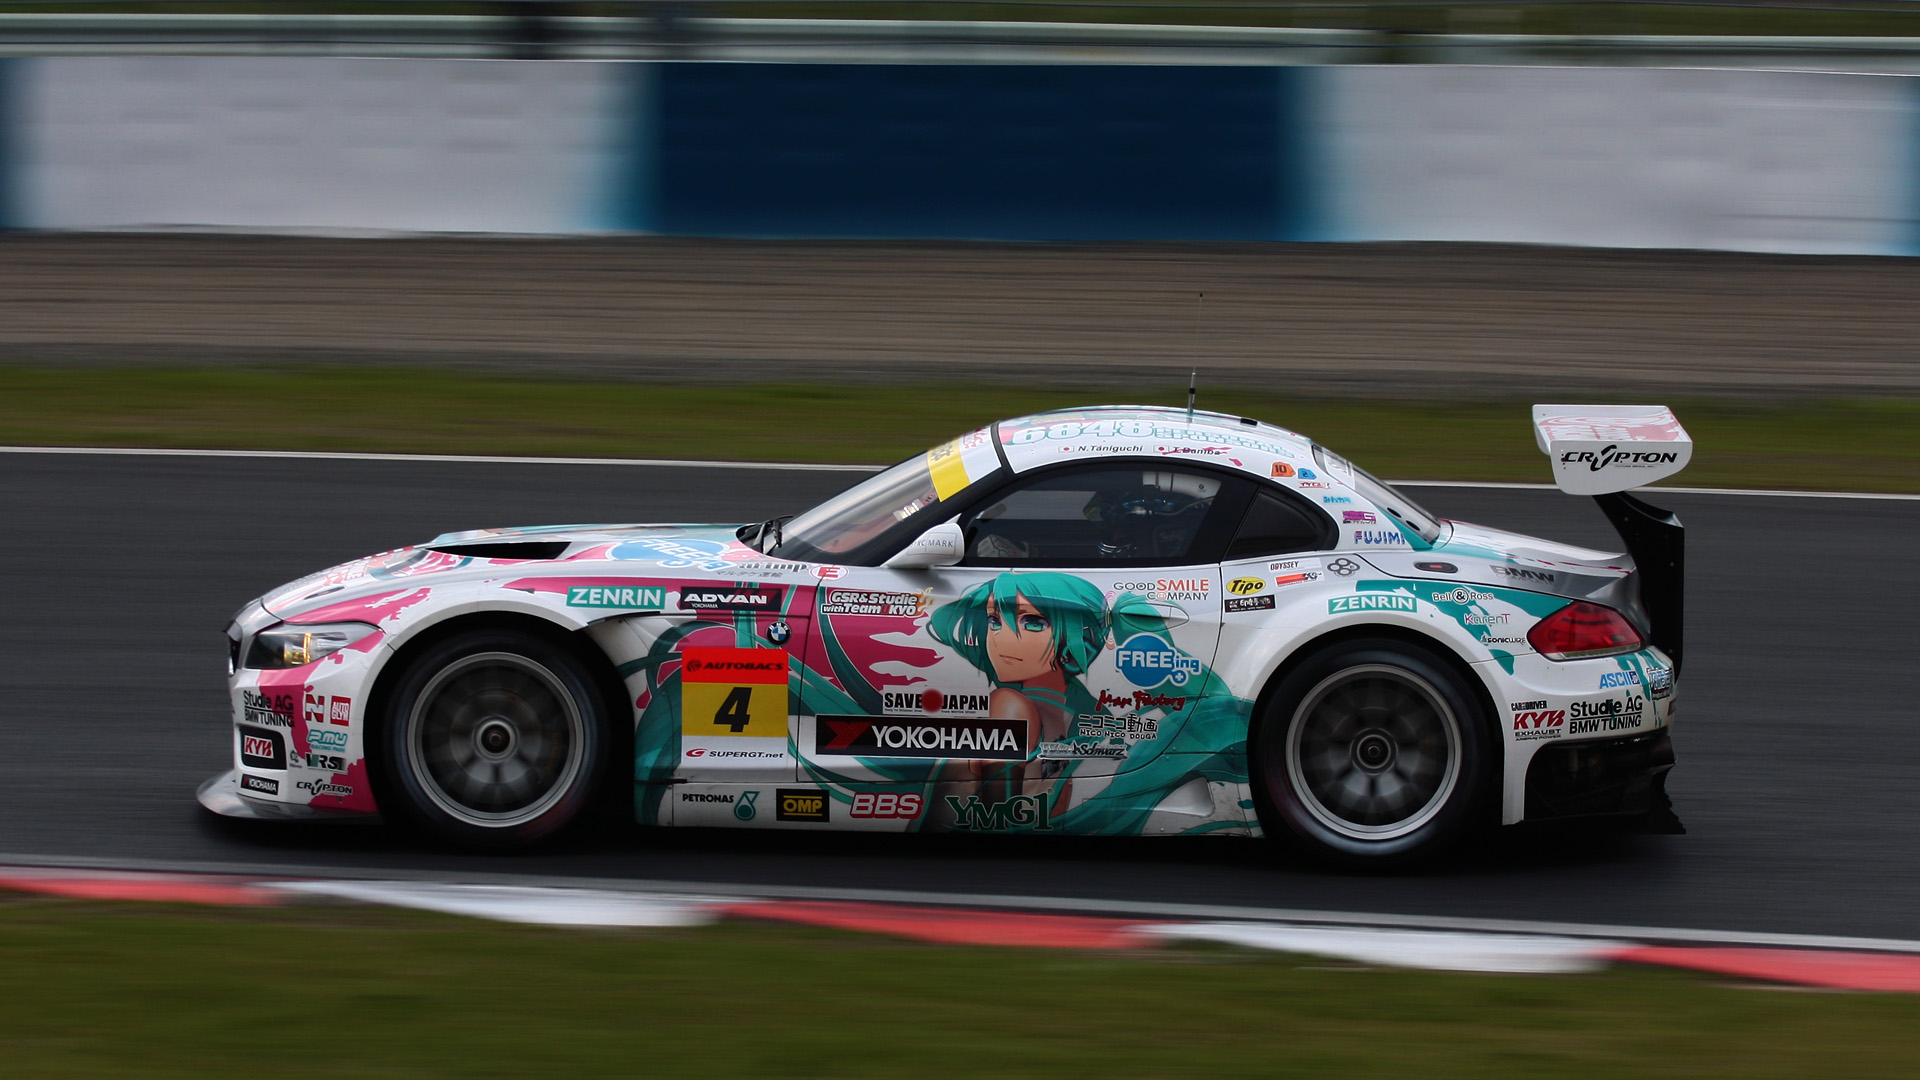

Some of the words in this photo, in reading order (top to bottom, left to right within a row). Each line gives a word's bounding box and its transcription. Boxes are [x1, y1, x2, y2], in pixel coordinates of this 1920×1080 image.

[1078, 445, 1143, 453] N.Taniguchi
[1562, 444, 1678, 472] CRYPTON
[1275, 464, 1287, 473] 10
[928, 540, 954, 548] MARK
[1355, 530, 1405, 545] FUJIMI
[818, 566, 840, 578] E
[1270, 561, 1299, 571] ODYSSEY
[1489, 565, 1555, 582] BMW
[1230, 580, 1264, 594] Tipo
[570, 588, 662, 606] ZENRIN
[684, 593, 767, 604] ADVAN
[1147, 592, 1209, 601] COMPANY
[1433, 592, 1451, 601] Bell
[1332, 597, 1413, 612] ZENRIN
[1465, 613, 1510, 624] KarenT
[704, 662, 784, 671] AUTOBACS
[1599, 671, 1632, 690] ASCII
[244, 690, 272, 709] Studie
[274, 694, 294, 711] AG
[884, 693, 923, 708] SAVE
[941, 695, 989, 711] JAPAN
[1570, 698, 1622, 717] Studie
[1624, 695, 1643, 713] AG
[713, 687, 753, 733] 4
[260, 711, 295, 728] TUNING
[1513, 710, 1566, 730] KYB
[1569, 719, 1599, 734] BMW
[1600, 714, 1642, 732] TUNING
[871, 725, 1019, 751] YOKOHAMA
[1515, 729, 1561, 737] EXHAUST
[245, 736, 274, 757] KYB
[708, 751, 784, 759] SUPERGT.net
[296, 779, 353, 796] CRYPTON
[682, 793, 735, 804] PETRONAS
[851, 795, 920, 814] BBS
[783, 800, 823, 813] OMP
